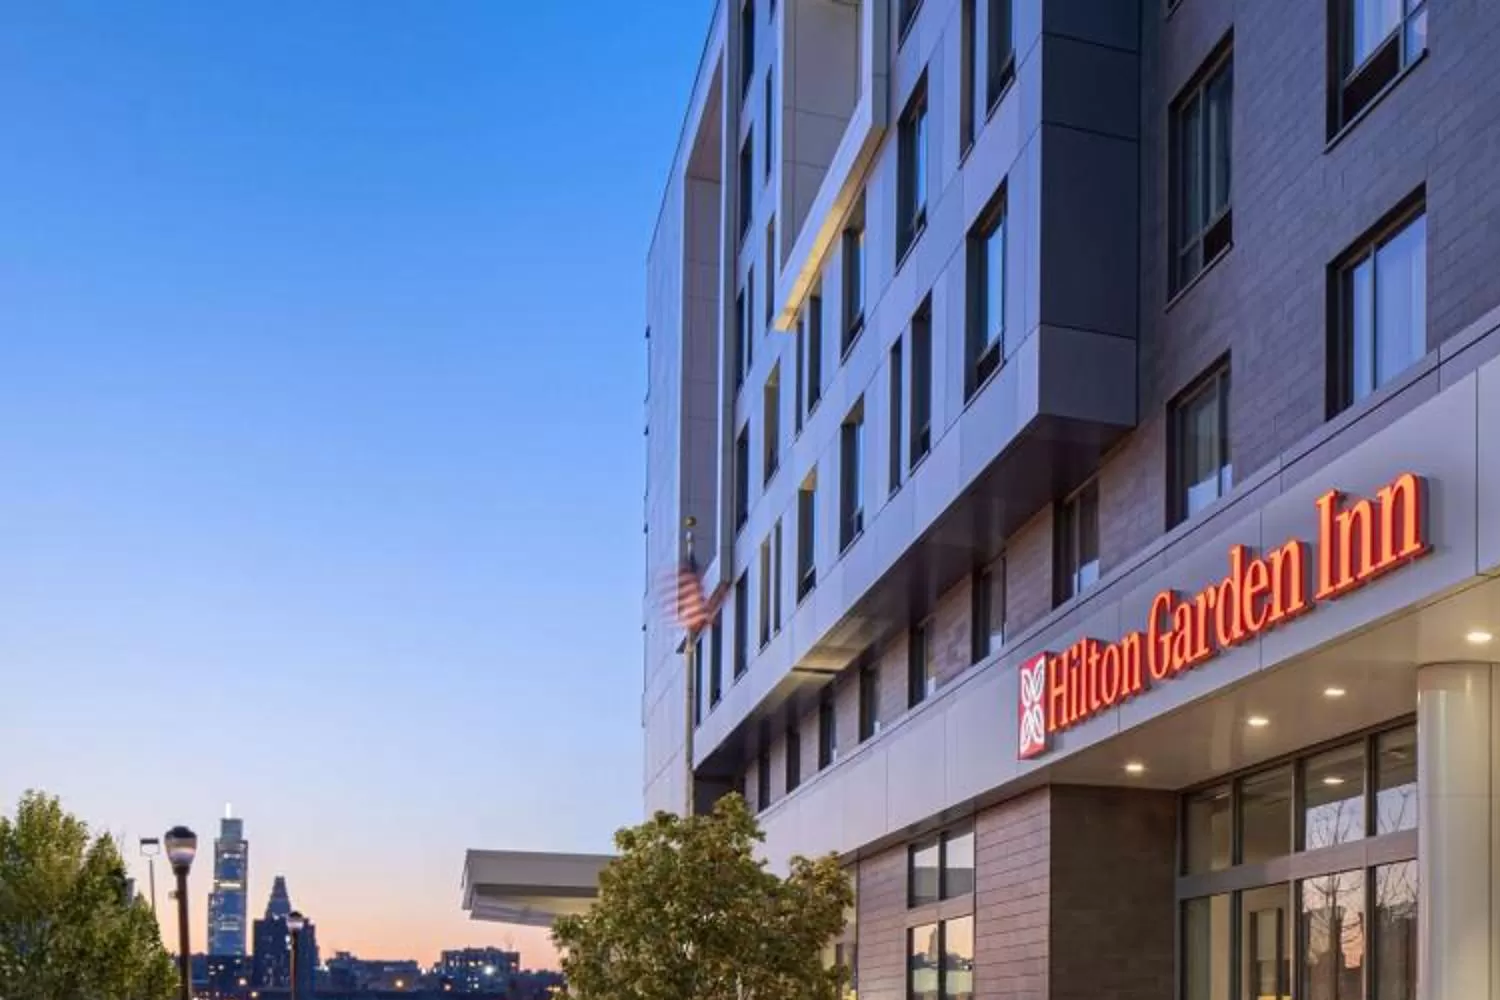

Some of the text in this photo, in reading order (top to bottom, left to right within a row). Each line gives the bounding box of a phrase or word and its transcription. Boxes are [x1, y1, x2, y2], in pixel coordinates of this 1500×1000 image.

[1047, 472, 1427, 732] Hilton Garden Inn
